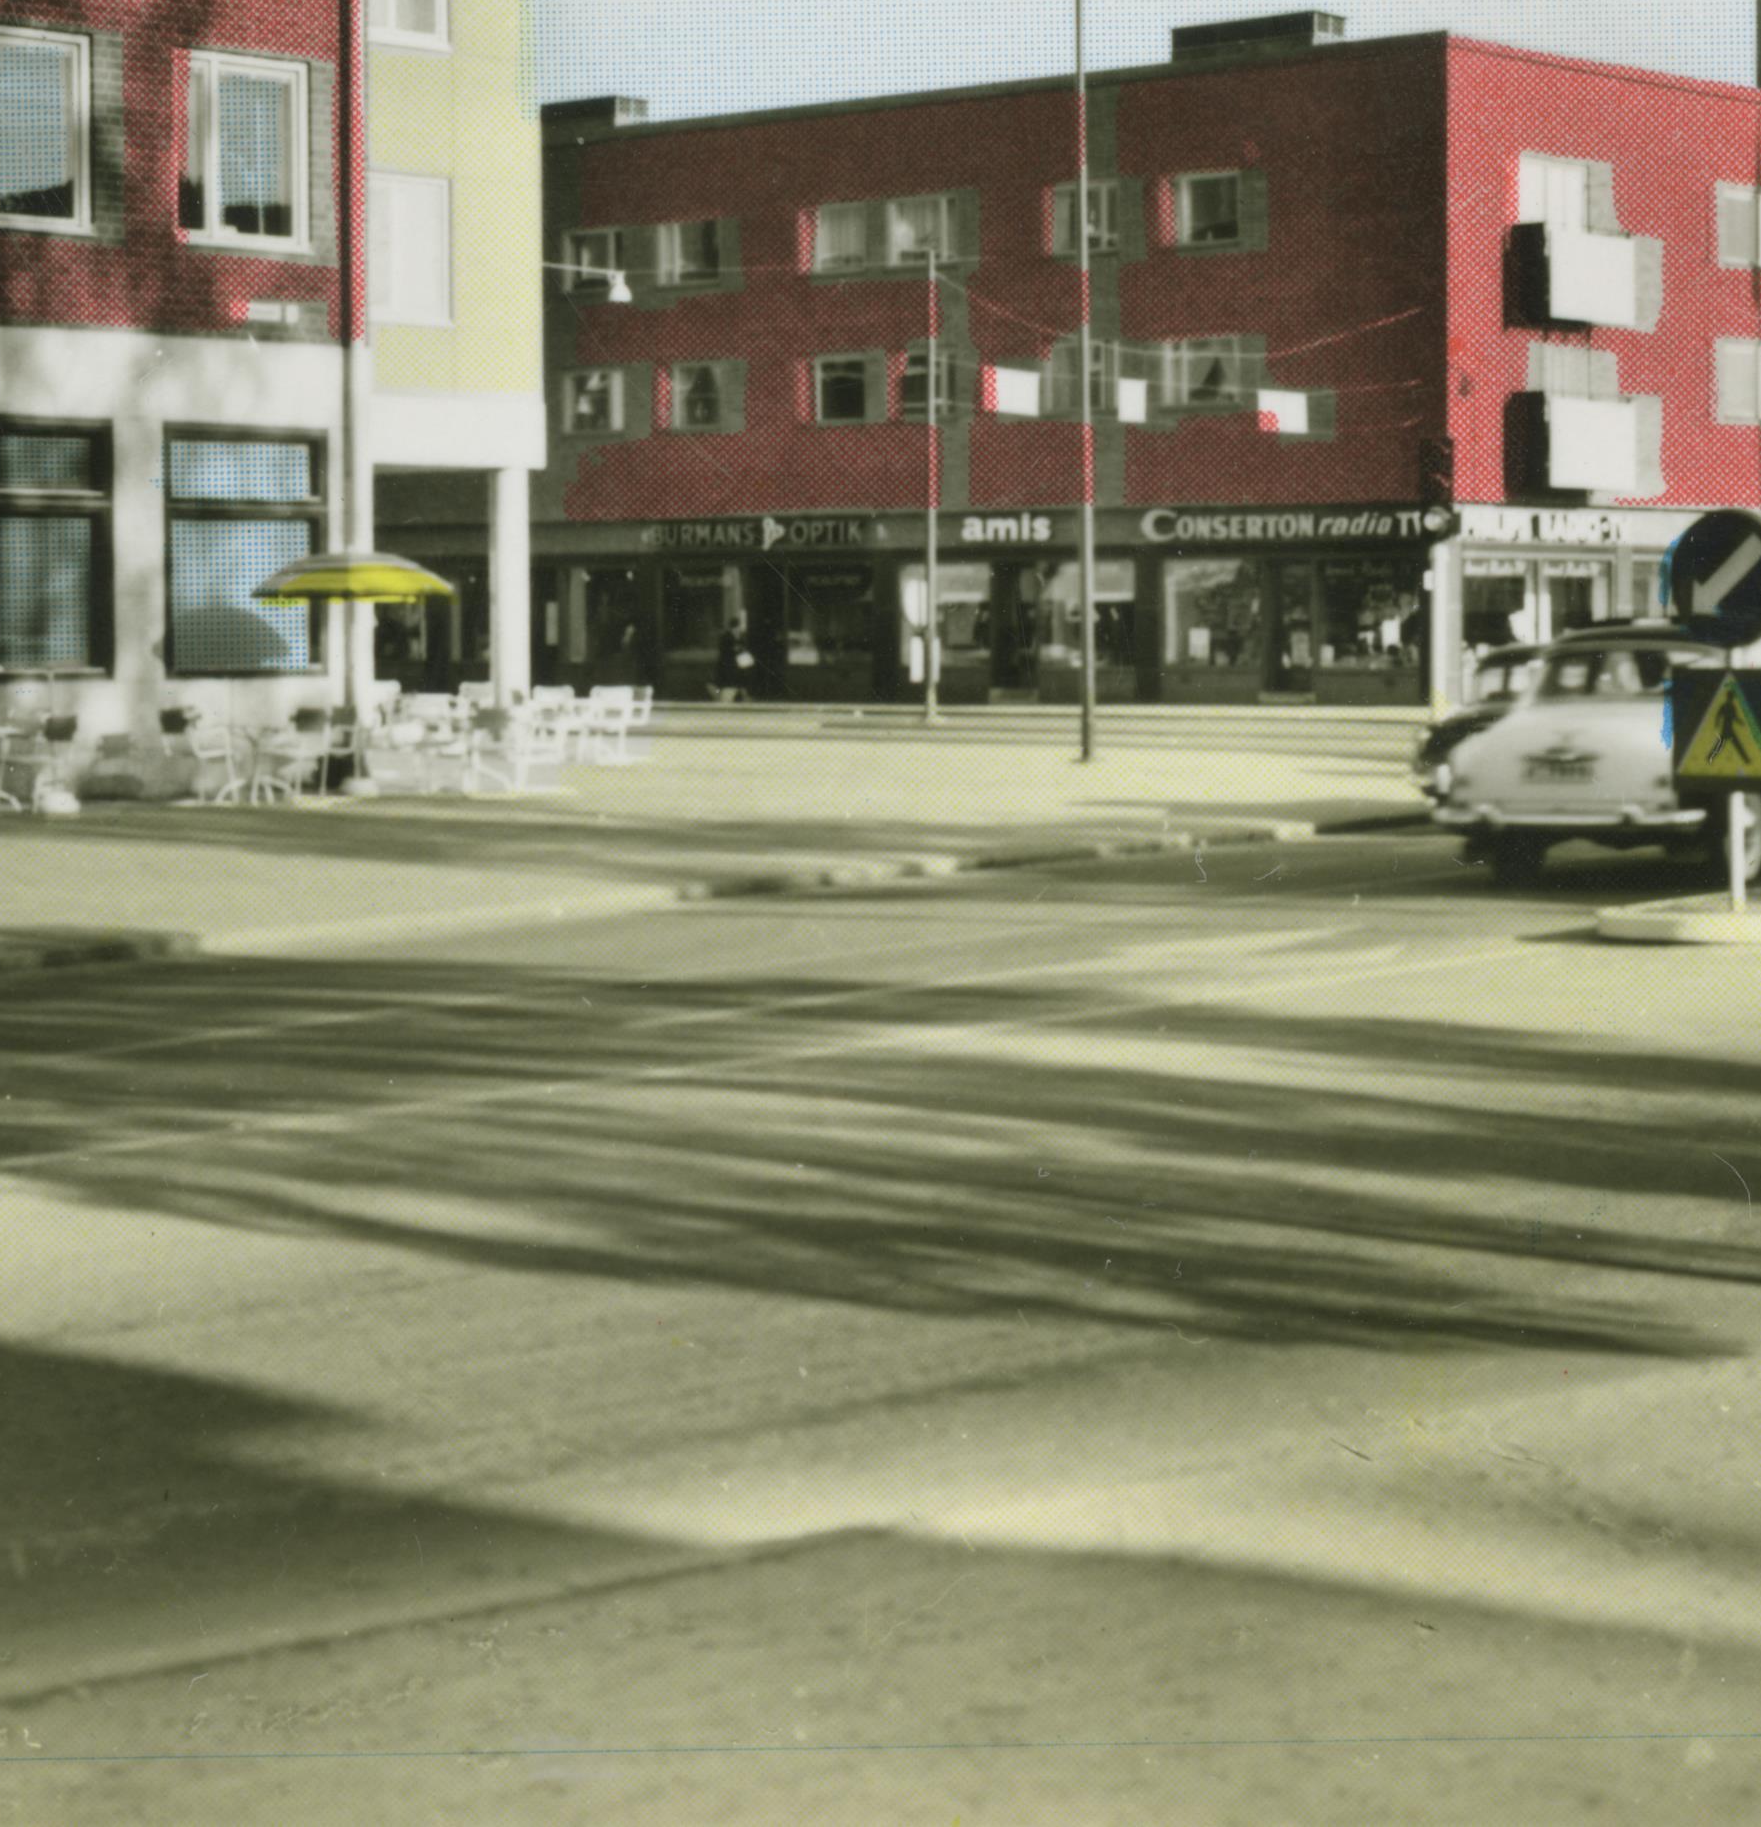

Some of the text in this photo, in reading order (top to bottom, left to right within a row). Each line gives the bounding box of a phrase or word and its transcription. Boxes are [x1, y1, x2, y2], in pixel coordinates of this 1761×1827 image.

[651, 520, 862, 547] BURMANS OPTIK
[961, 512, 1052, 542] amis
[1318, 511, 1393, 536] radio
